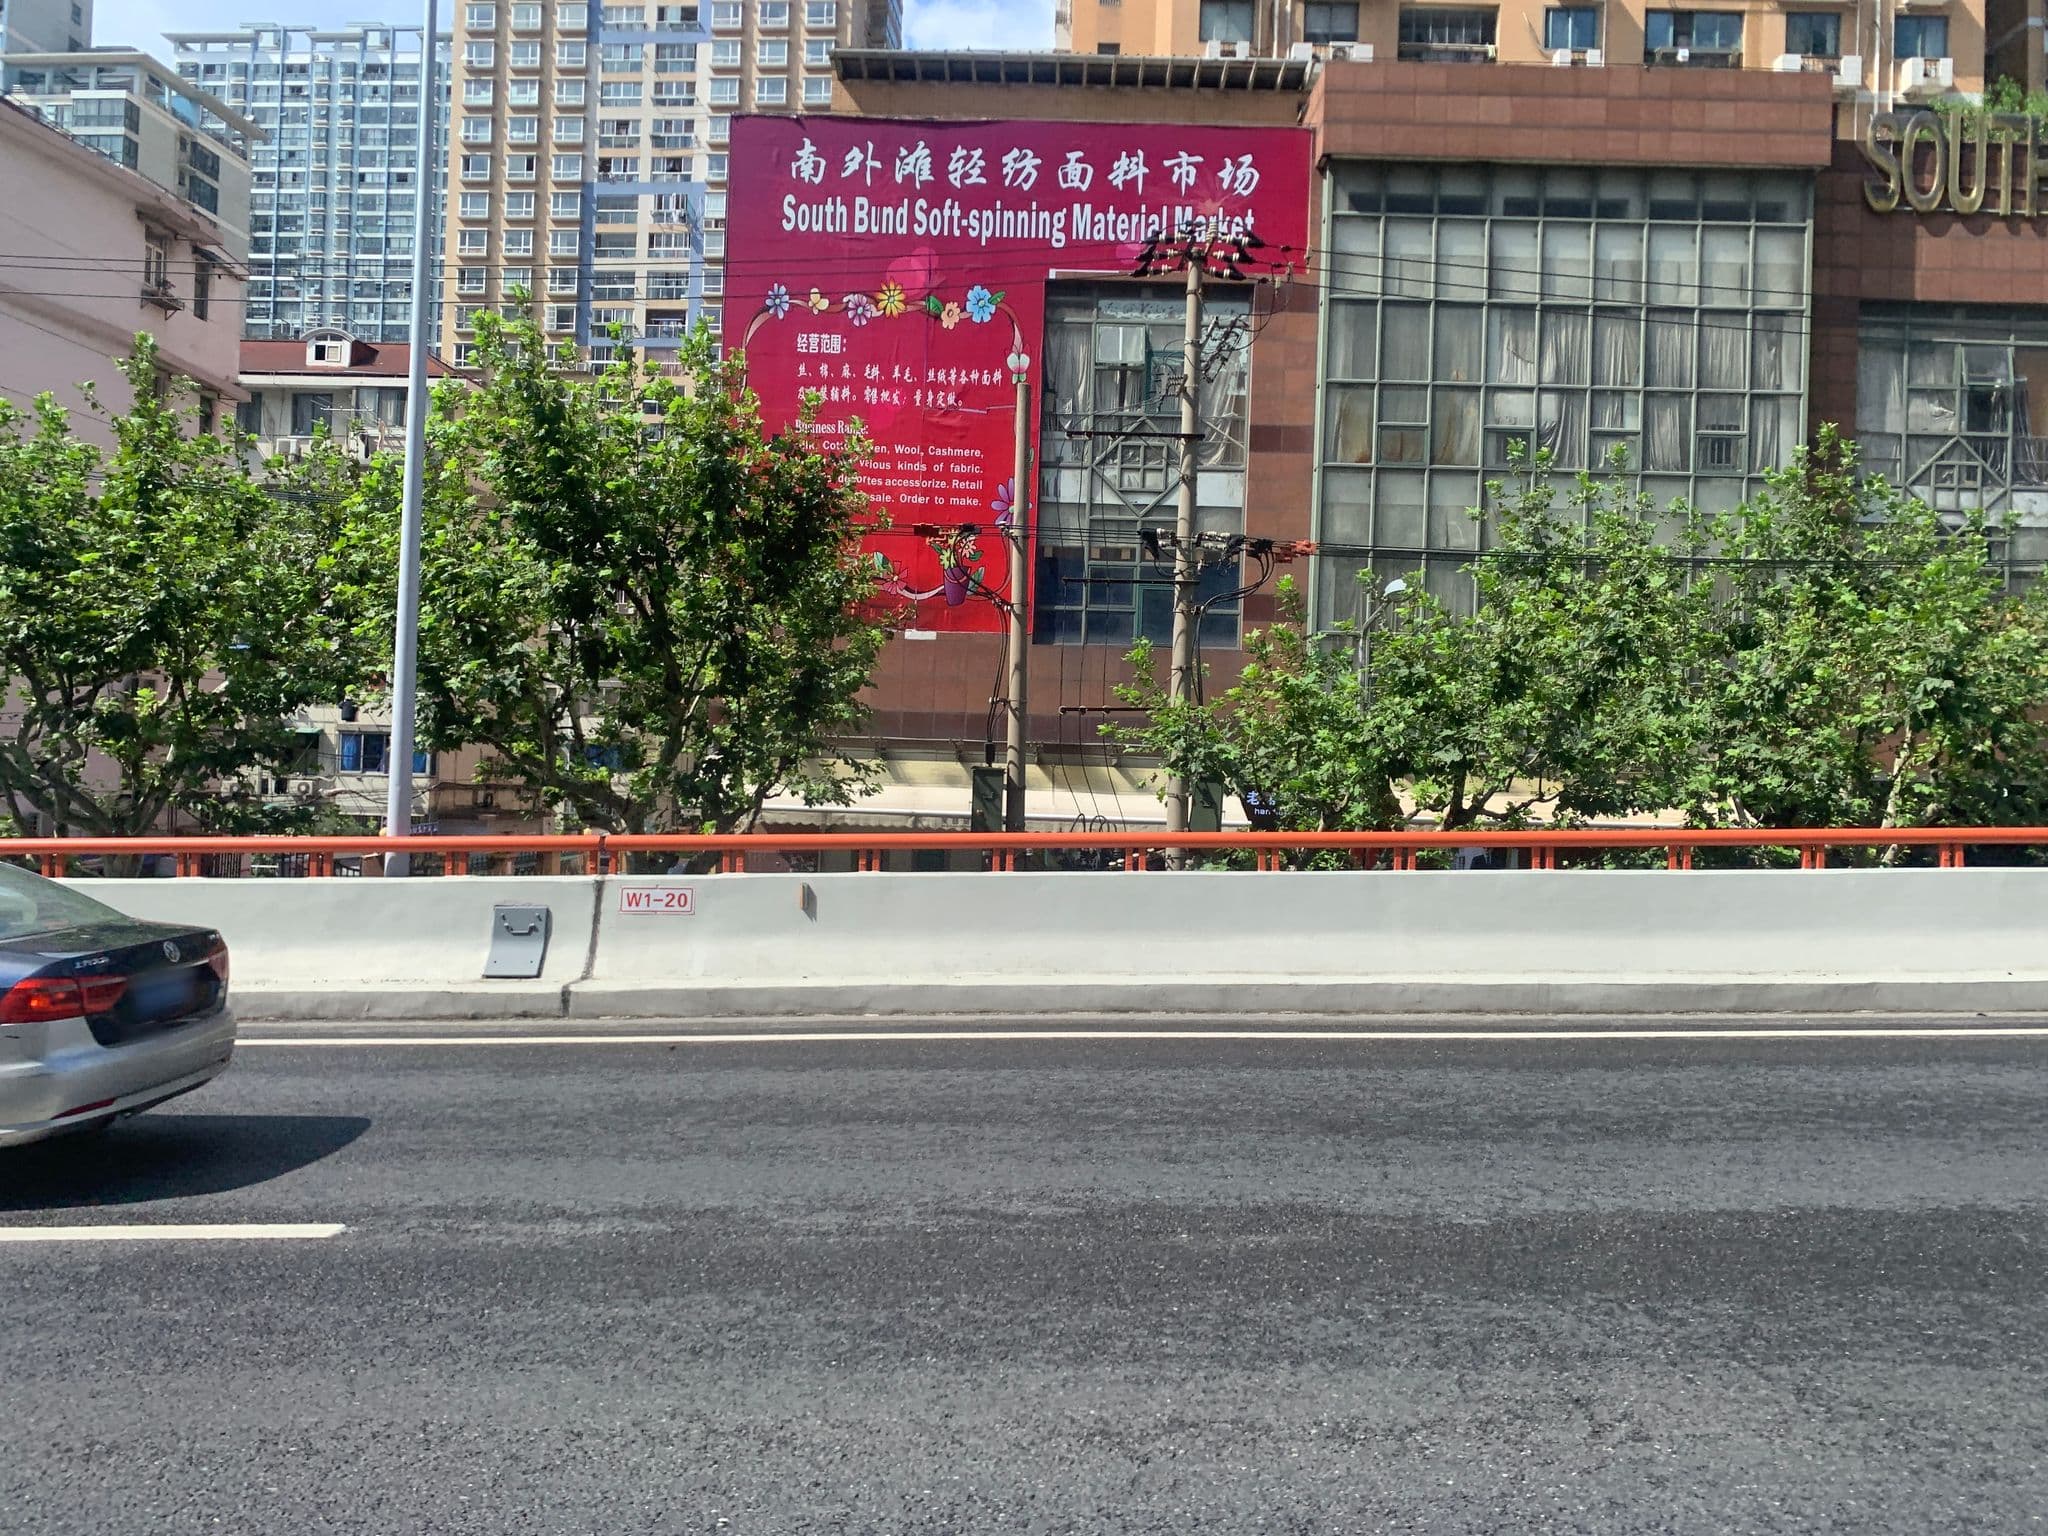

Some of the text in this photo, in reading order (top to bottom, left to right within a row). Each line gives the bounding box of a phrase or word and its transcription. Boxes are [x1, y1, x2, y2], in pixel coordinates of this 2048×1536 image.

[791, 138, 1260, 196] 南外滩轻纺面料市场
[782, 194, 847, 233] South
[854, 197, 908, 236] Bund
[913, 198, 1066, 247] Soft-spinning
[1072, 203, 1168, 242] Material
[797, 333, 847, 354] 经营范围：
[894, 444, 924, 457] Wool,
[928, 446, 984, 459] Cashmere,
[897, 461, 927, 472] kinds
[933, 462, 944, 472] of
[950, 463, 984, 474] fabric.
[885, 478, 949, 489] accessorize.
[952, 480, 983, 490] Retail
[900, 493, 930, 504] Order
[934, 496, 945, 505] to
[950, 496, 982, 506] make.
[626, 892, 688, 908] W1-20
